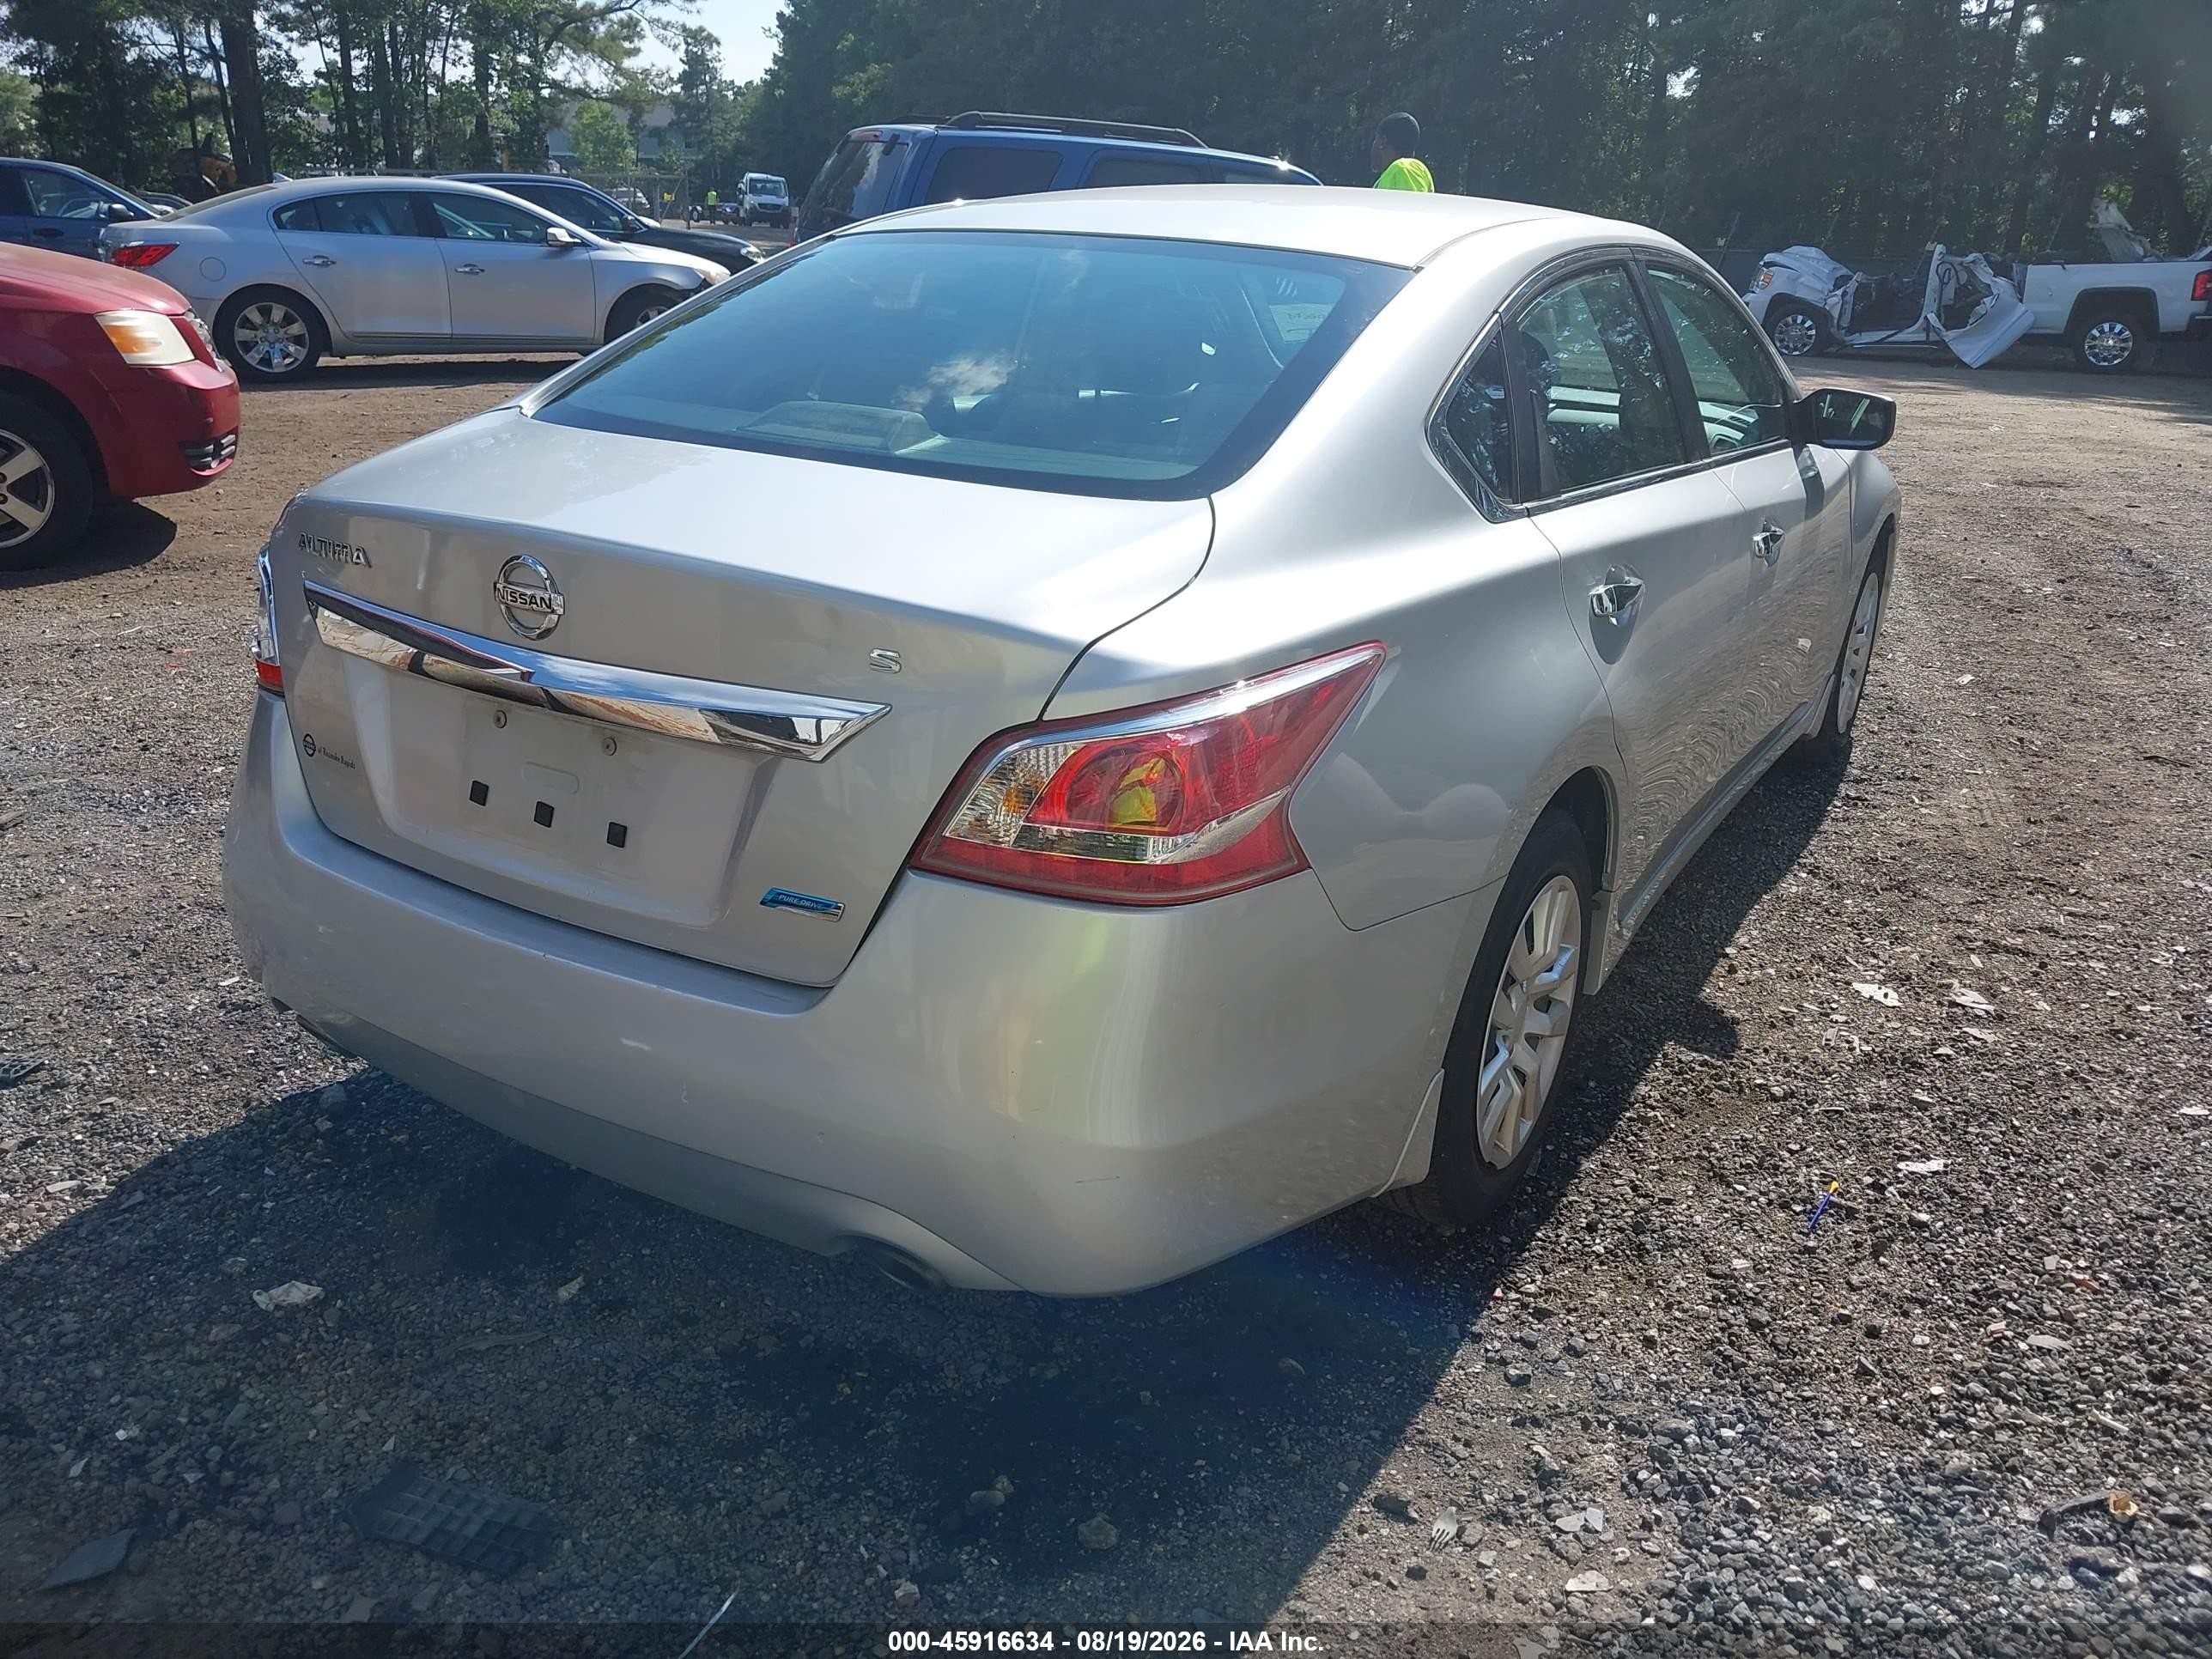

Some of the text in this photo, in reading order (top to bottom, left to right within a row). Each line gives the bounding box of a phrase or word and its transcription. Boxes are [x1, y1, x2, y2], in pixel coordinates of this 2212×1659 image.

[298, 532, 372, 568] ALTIMA
[496, 587, 552, 611] NISSAN
[869, 647, 902, 674] S
